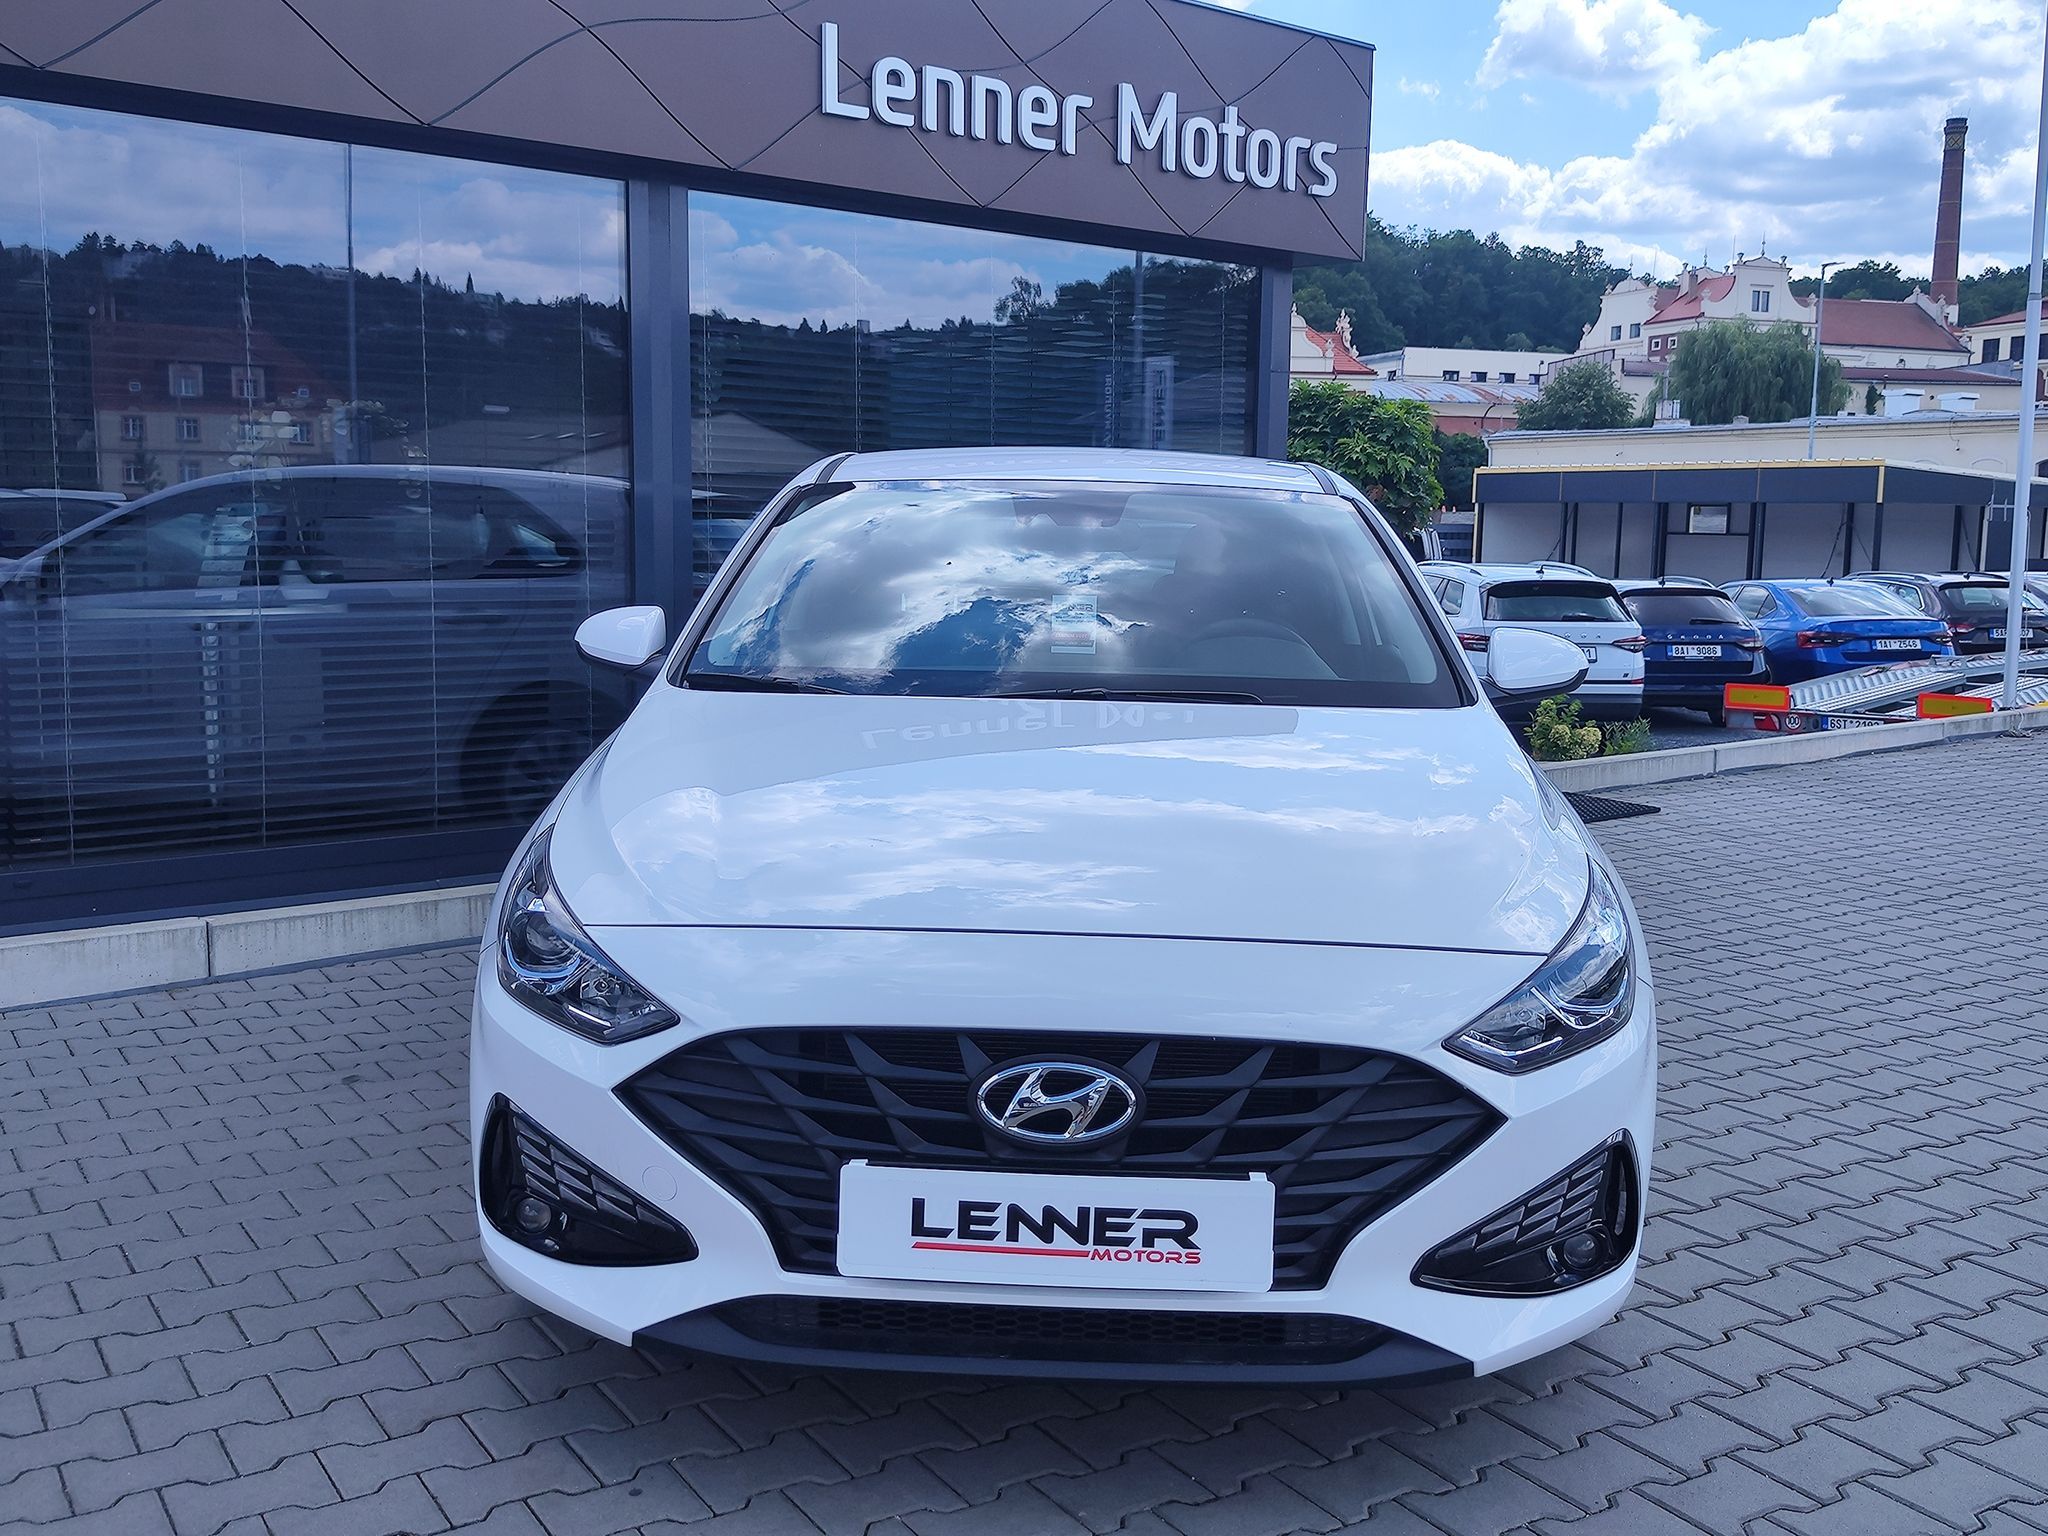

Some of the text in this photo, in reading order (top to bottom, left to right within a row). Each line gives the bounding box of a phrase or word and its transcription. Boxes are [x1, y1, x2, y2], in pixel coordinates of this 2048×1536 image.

[820, 21, 1339, 198] Lenner Motors
[1674, 646, 1718, 656] 8AI 9086
[1830, 718, 1848, 729] 6ST
[911, 1197, 1201, 1250] LENNER
[1090, 1248, 1201, 1265] MOTORS
